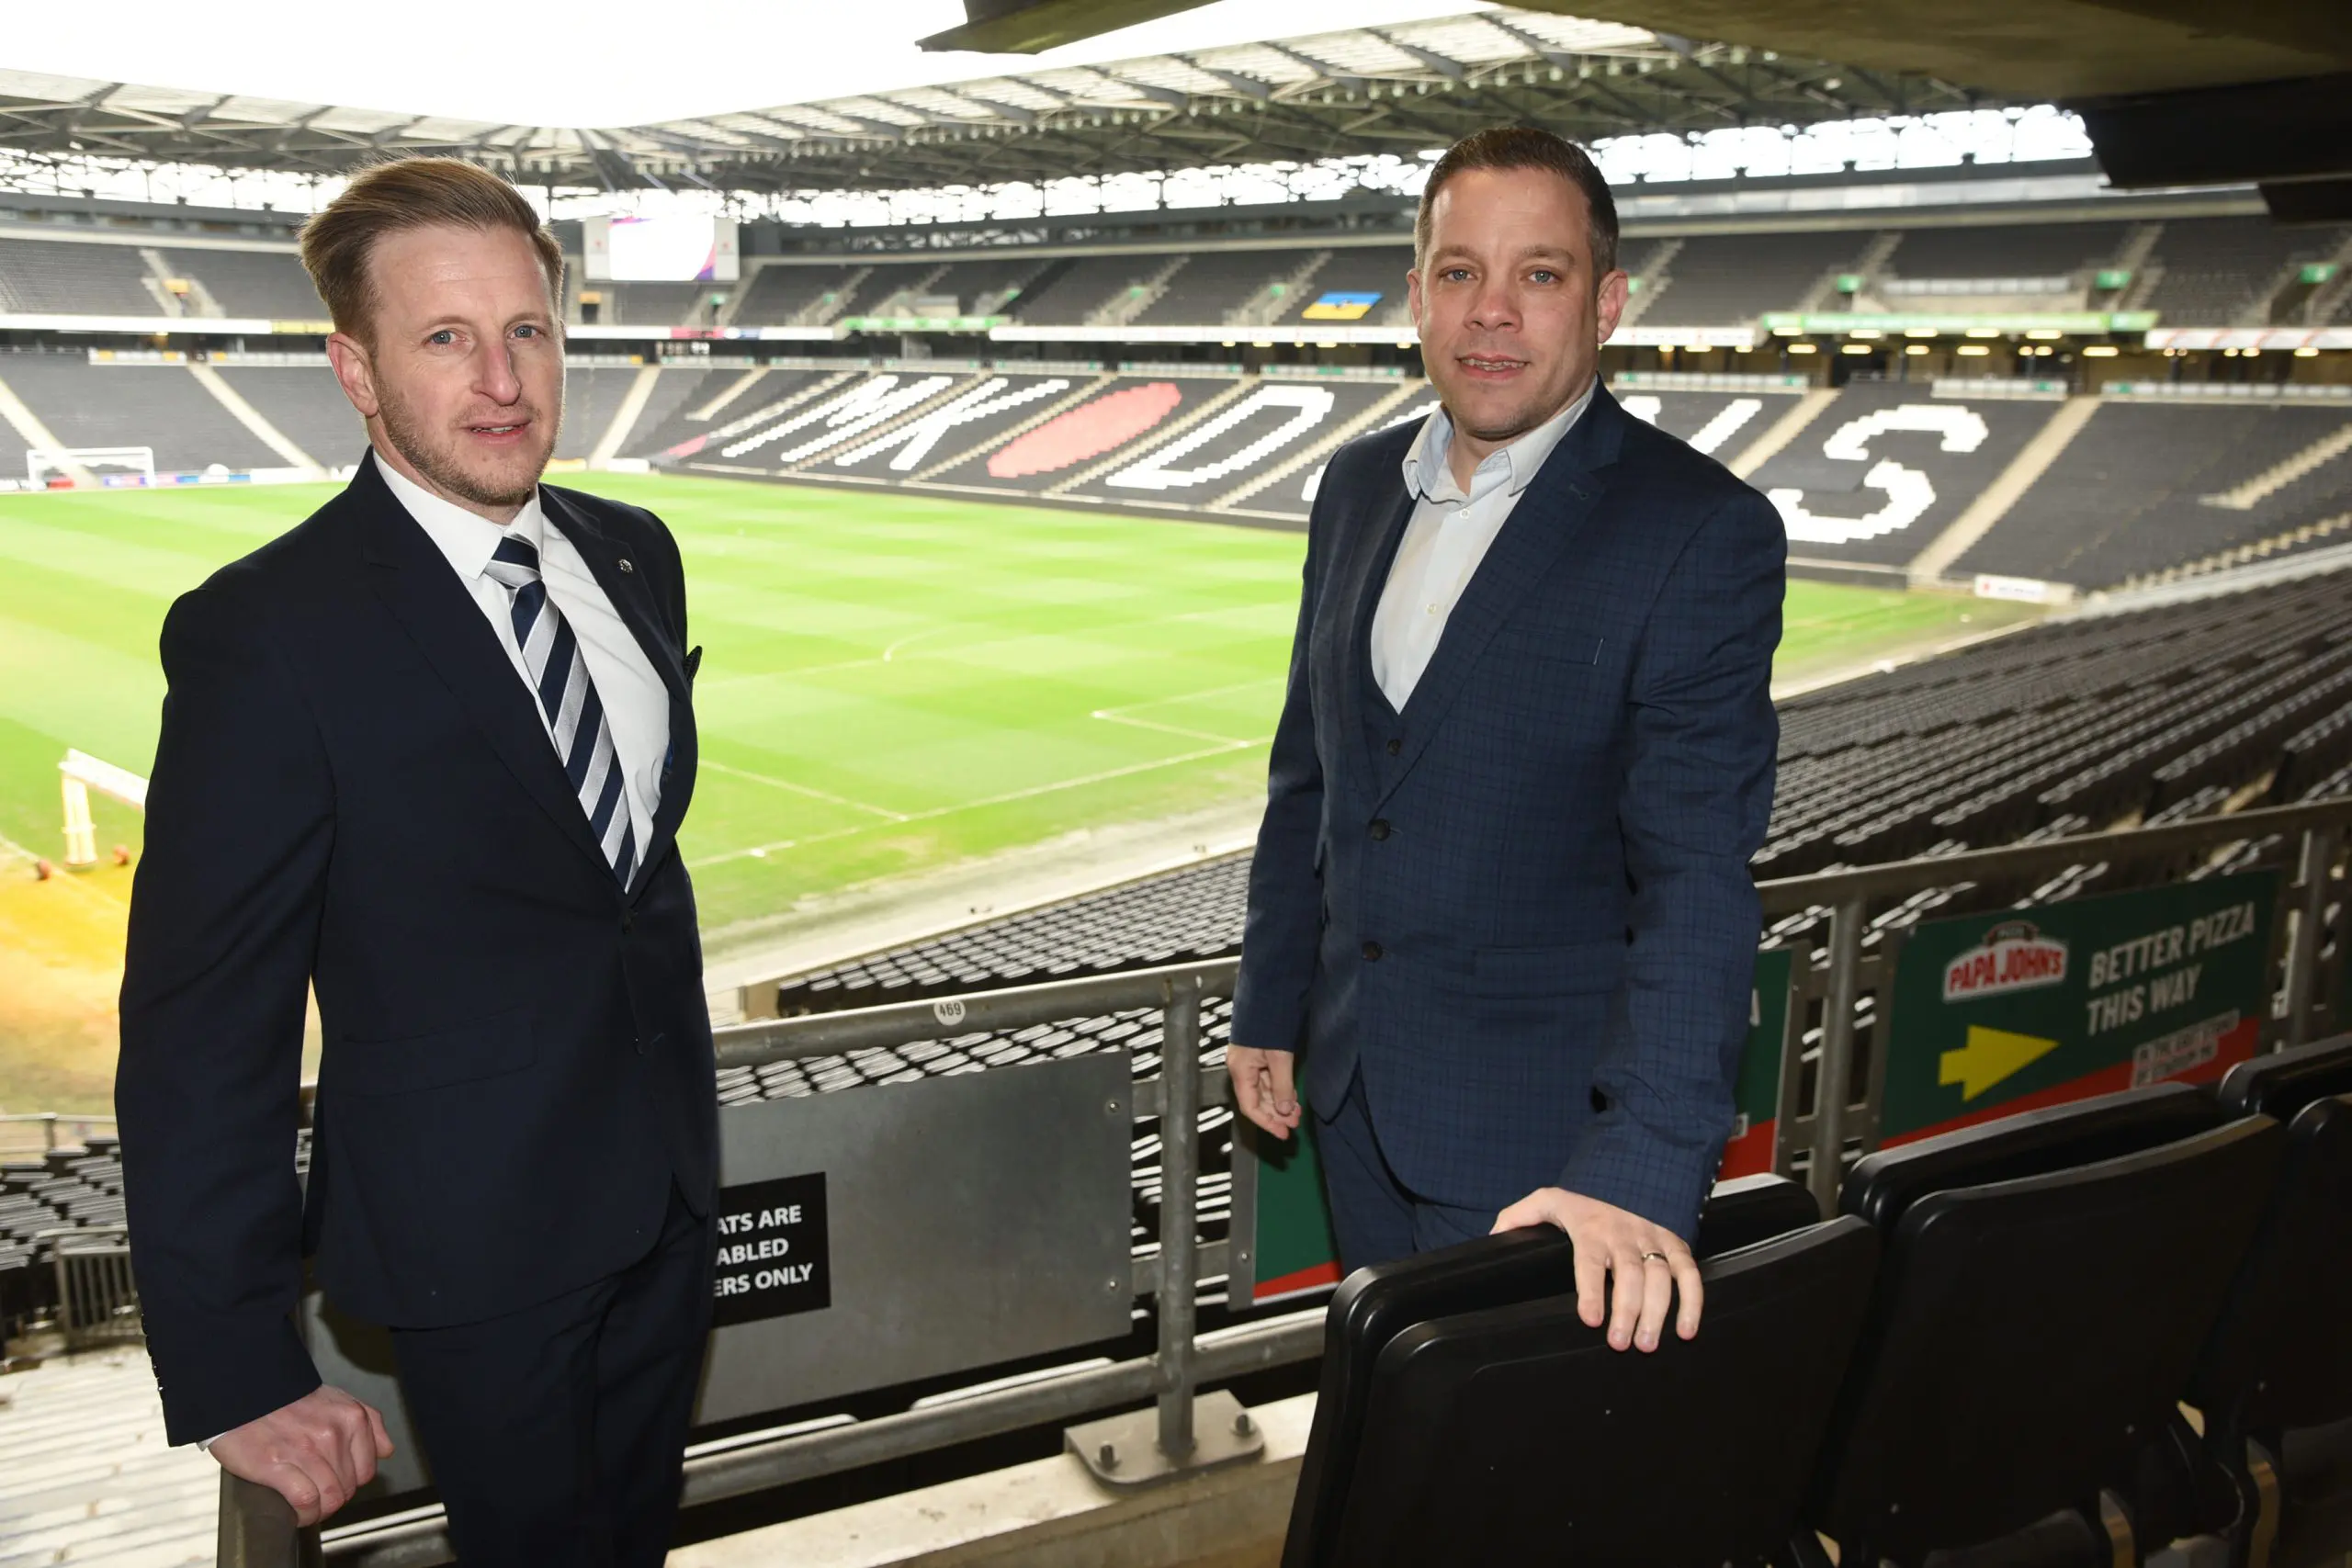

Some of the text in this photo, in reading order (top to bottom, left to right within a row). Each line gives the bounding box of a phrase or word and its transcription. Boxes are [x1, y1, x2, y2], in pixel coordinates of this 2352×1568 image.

[2088, 901, 2256, 989] BETTER PIZZA
[1949, 952, 1996, 993] PAPA
[939, 1002, 962, 1017] 469
[2086, 964, 2203, 1037] THIS WAY
[717, 1204, 803, 1235] ATS ARE
[716, 1237, 789, 1267] ABLED
[713, 1262, 814, 1298] ERS ONLY
